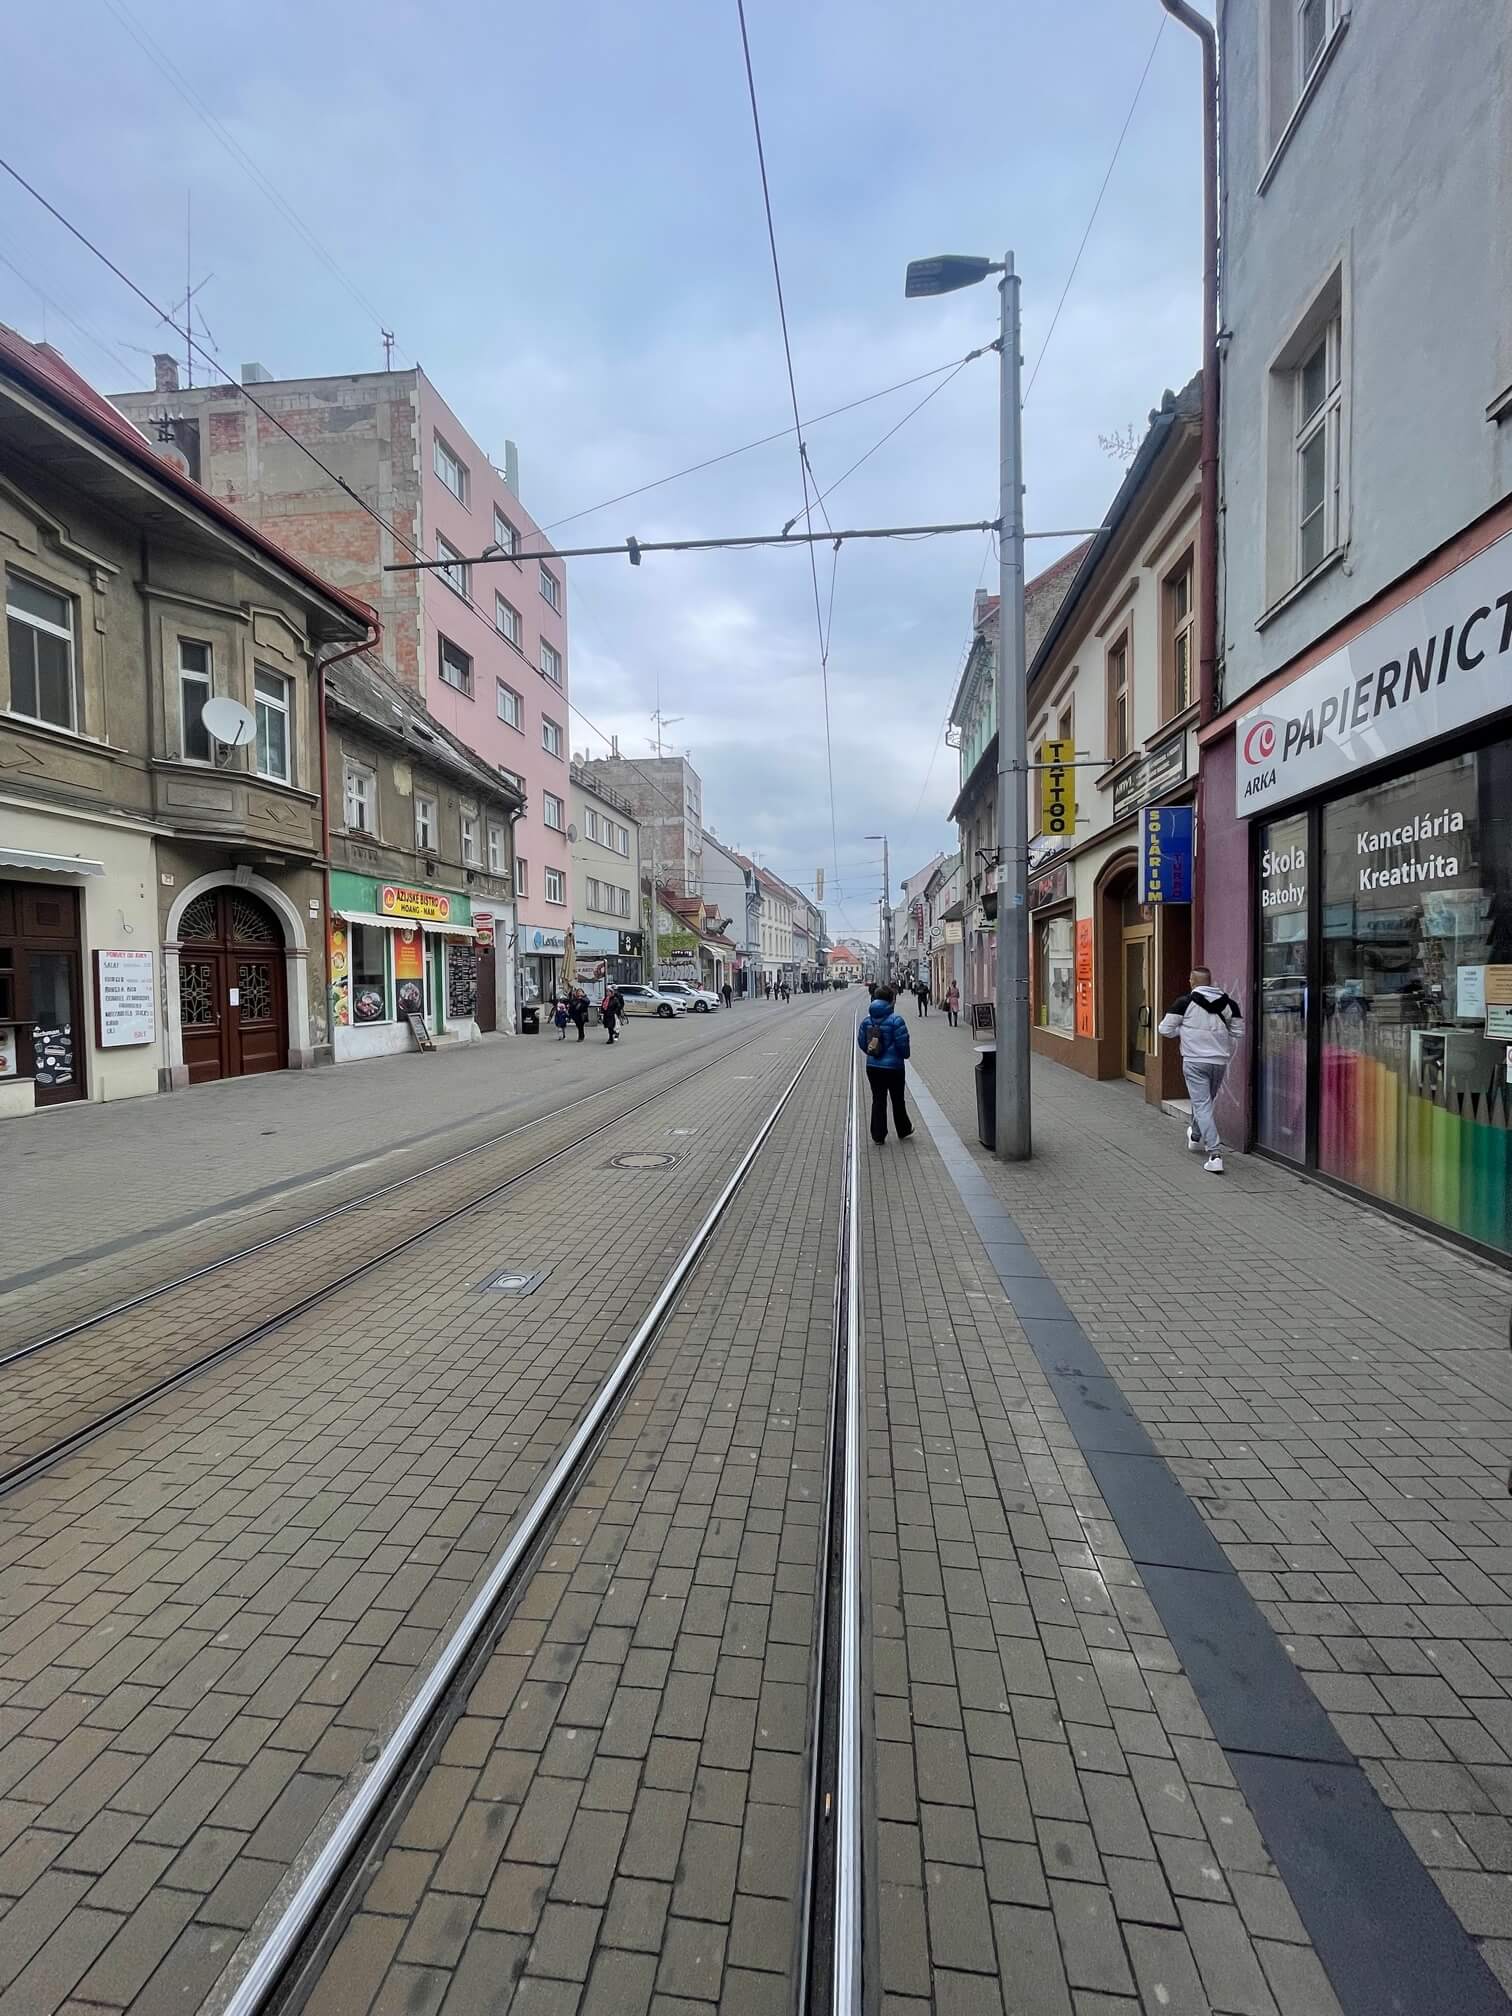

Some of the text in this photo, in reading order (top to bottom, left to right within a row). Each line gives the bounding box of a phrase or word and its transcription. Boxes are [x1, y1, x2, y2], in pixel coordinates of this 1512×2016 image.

[1049, 743, 1065, 832] TATTOO
[1244, 768, 1276, 798] ARKA
[1357, 808, 1464, 854] Kancelária
[1148, 810, 1163, 901] SOLARIUM
[1262, 846, 1305, 878] Škola
[1359, 854, 1458, 890] Kreativita
[420, 894, 439, 907] BISTRO
[1262, 883, 1304, 906] Batohy
